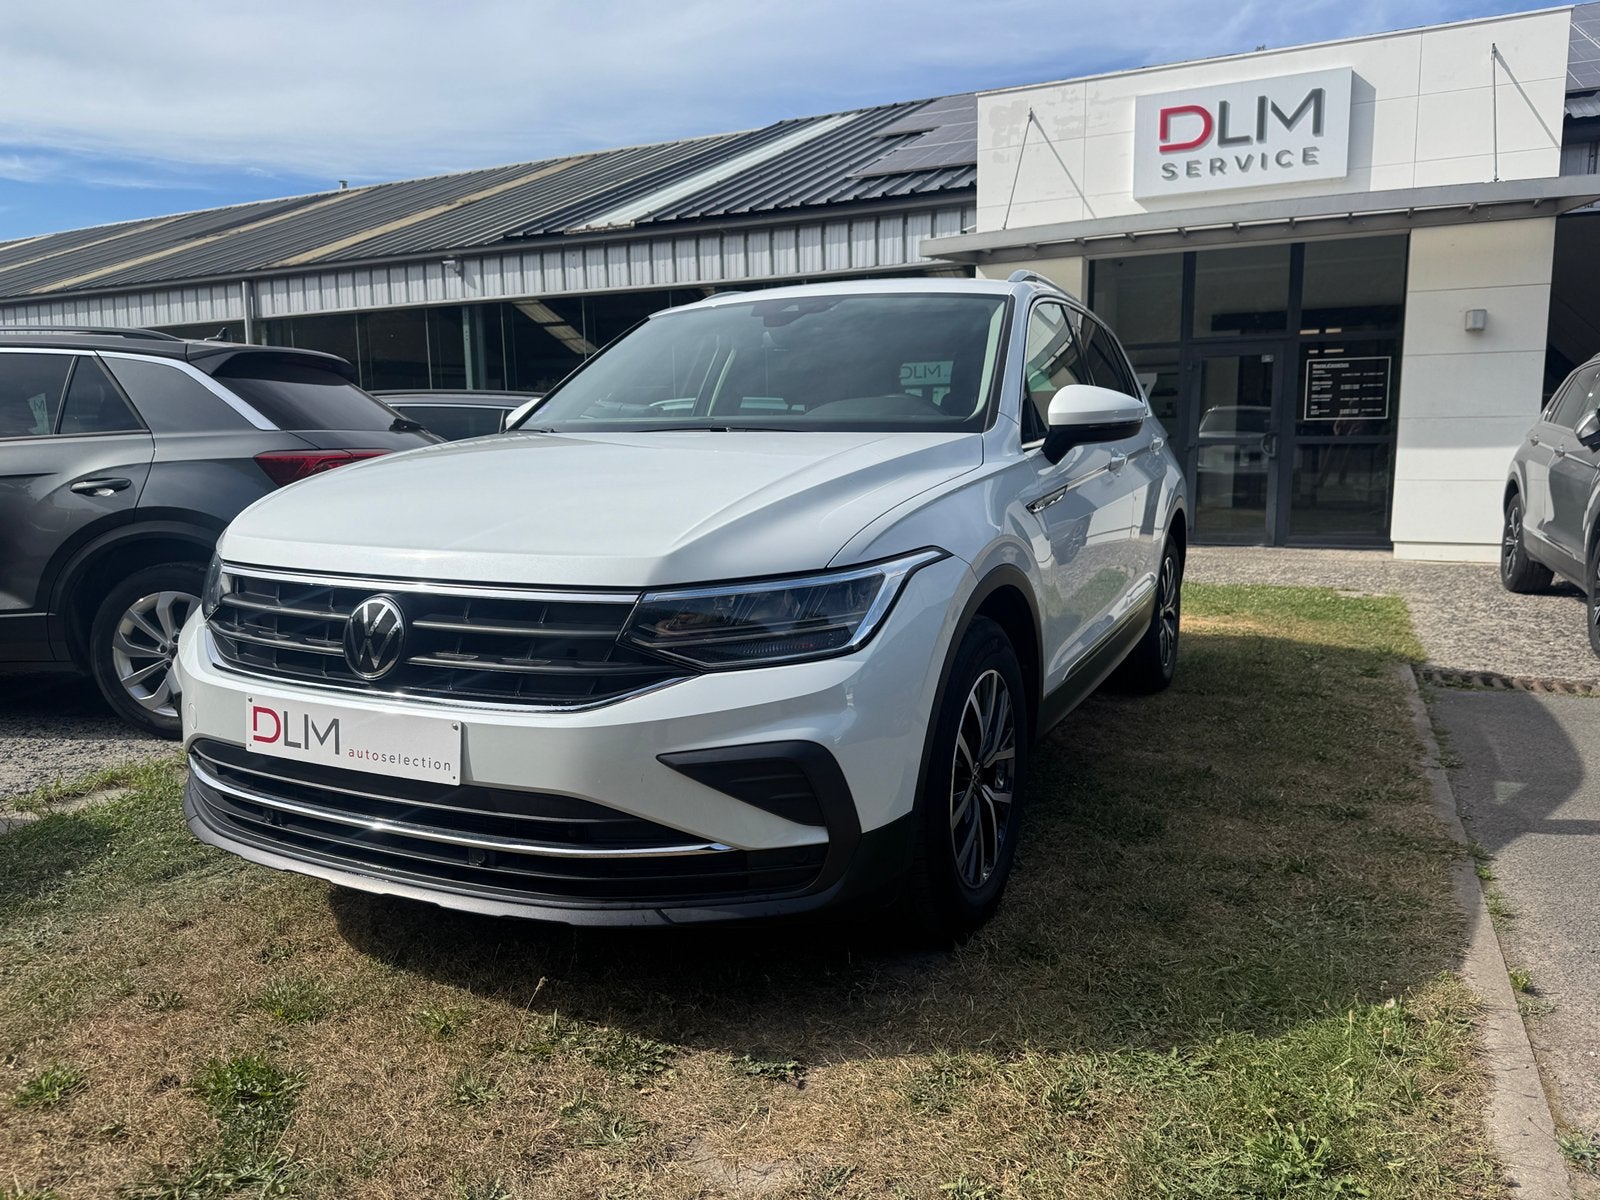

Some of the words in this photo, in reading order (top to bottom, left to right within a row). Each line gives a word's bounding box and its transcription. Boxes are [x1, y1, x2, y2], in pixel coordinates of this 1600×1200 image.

[1159, 87, 1326, 154] DLM
[1161, 146, 1320, 181] SERVICE
[252, 705, 340, 755] DLM
[348, 747, 451, 772] autoselection
